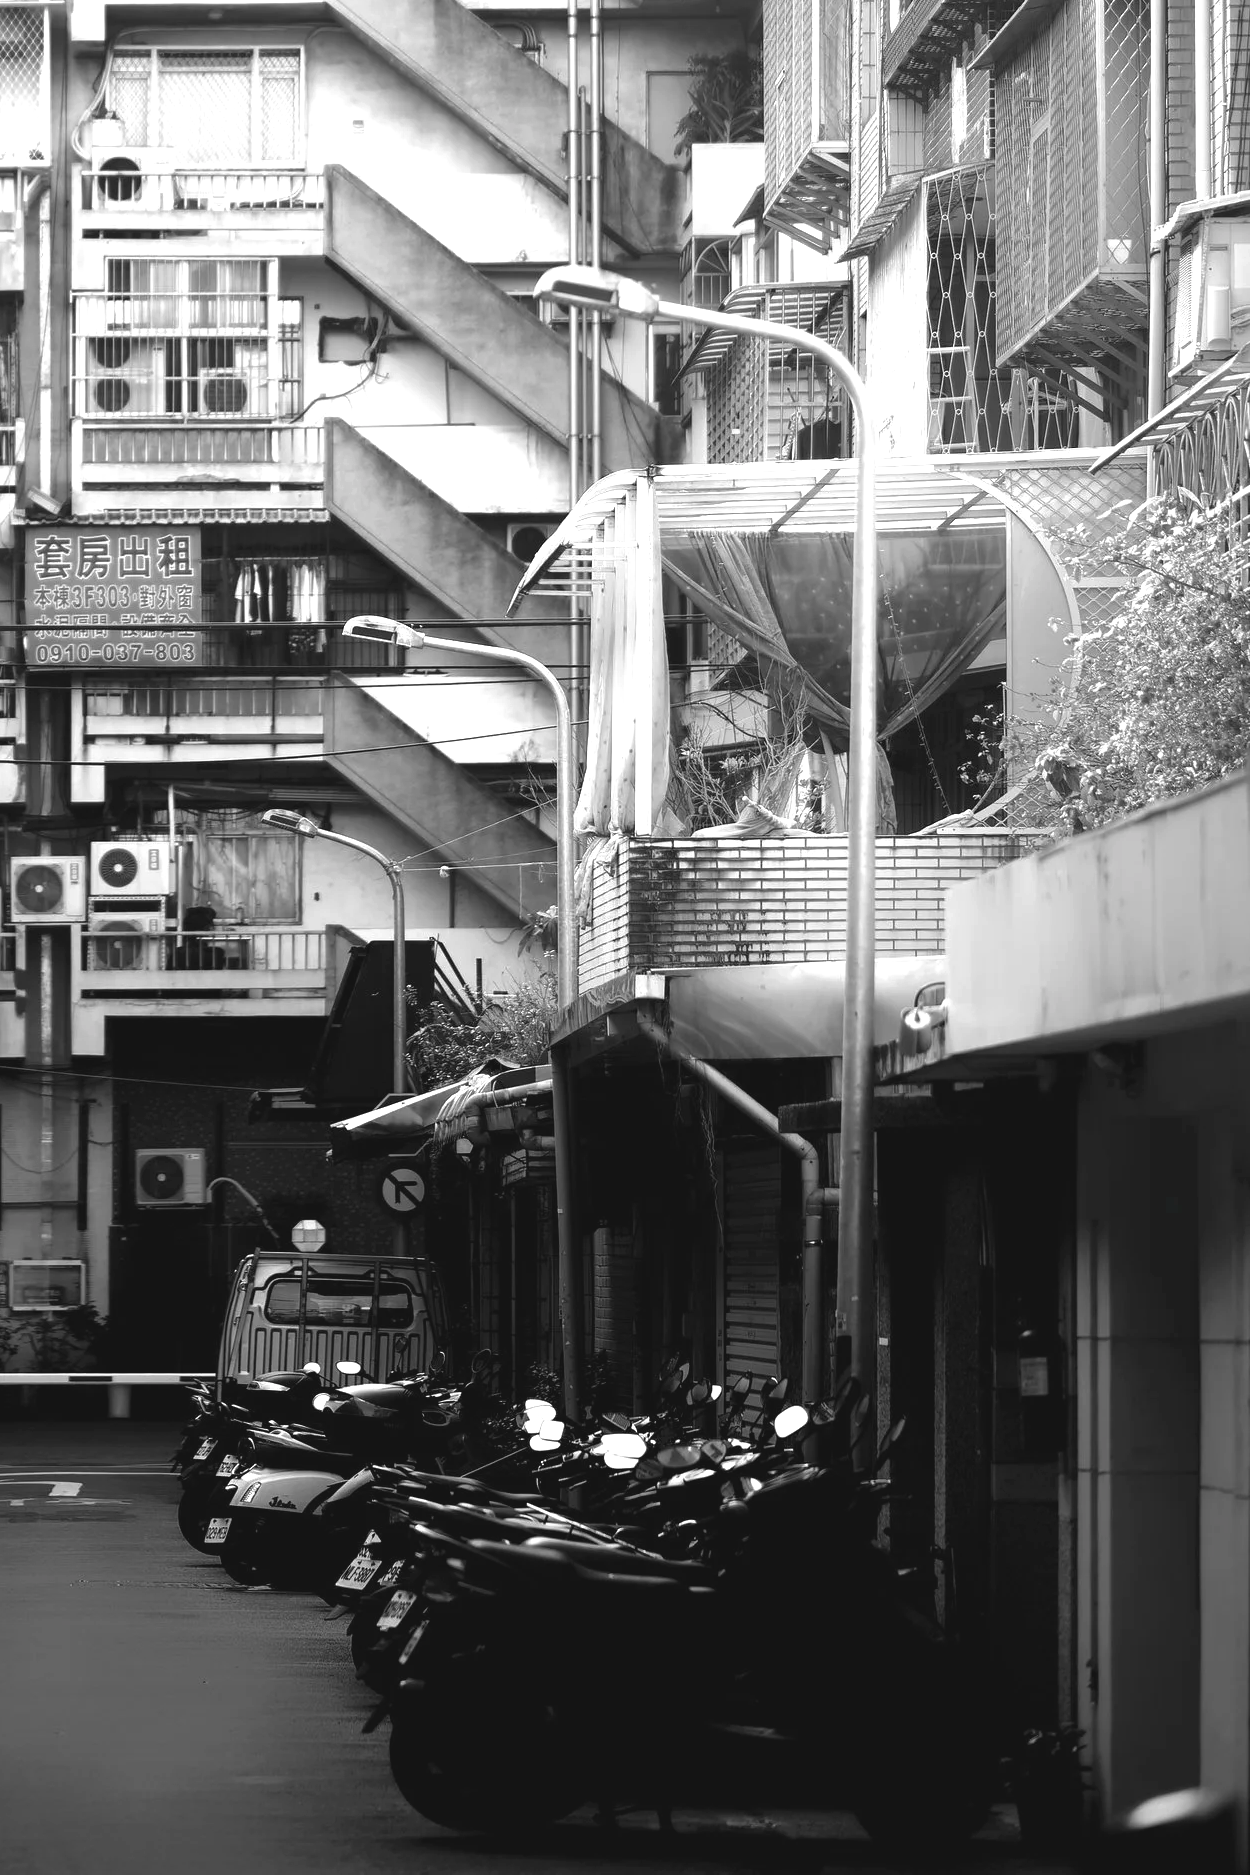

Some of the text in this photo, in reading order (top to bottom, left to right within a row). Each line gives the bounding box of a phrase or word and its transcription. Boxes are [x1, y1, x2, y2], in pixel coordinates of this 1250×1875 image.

[34, 534, 194, 580] 套房出租
[36, 643, 195, 663] 0910-037-803
